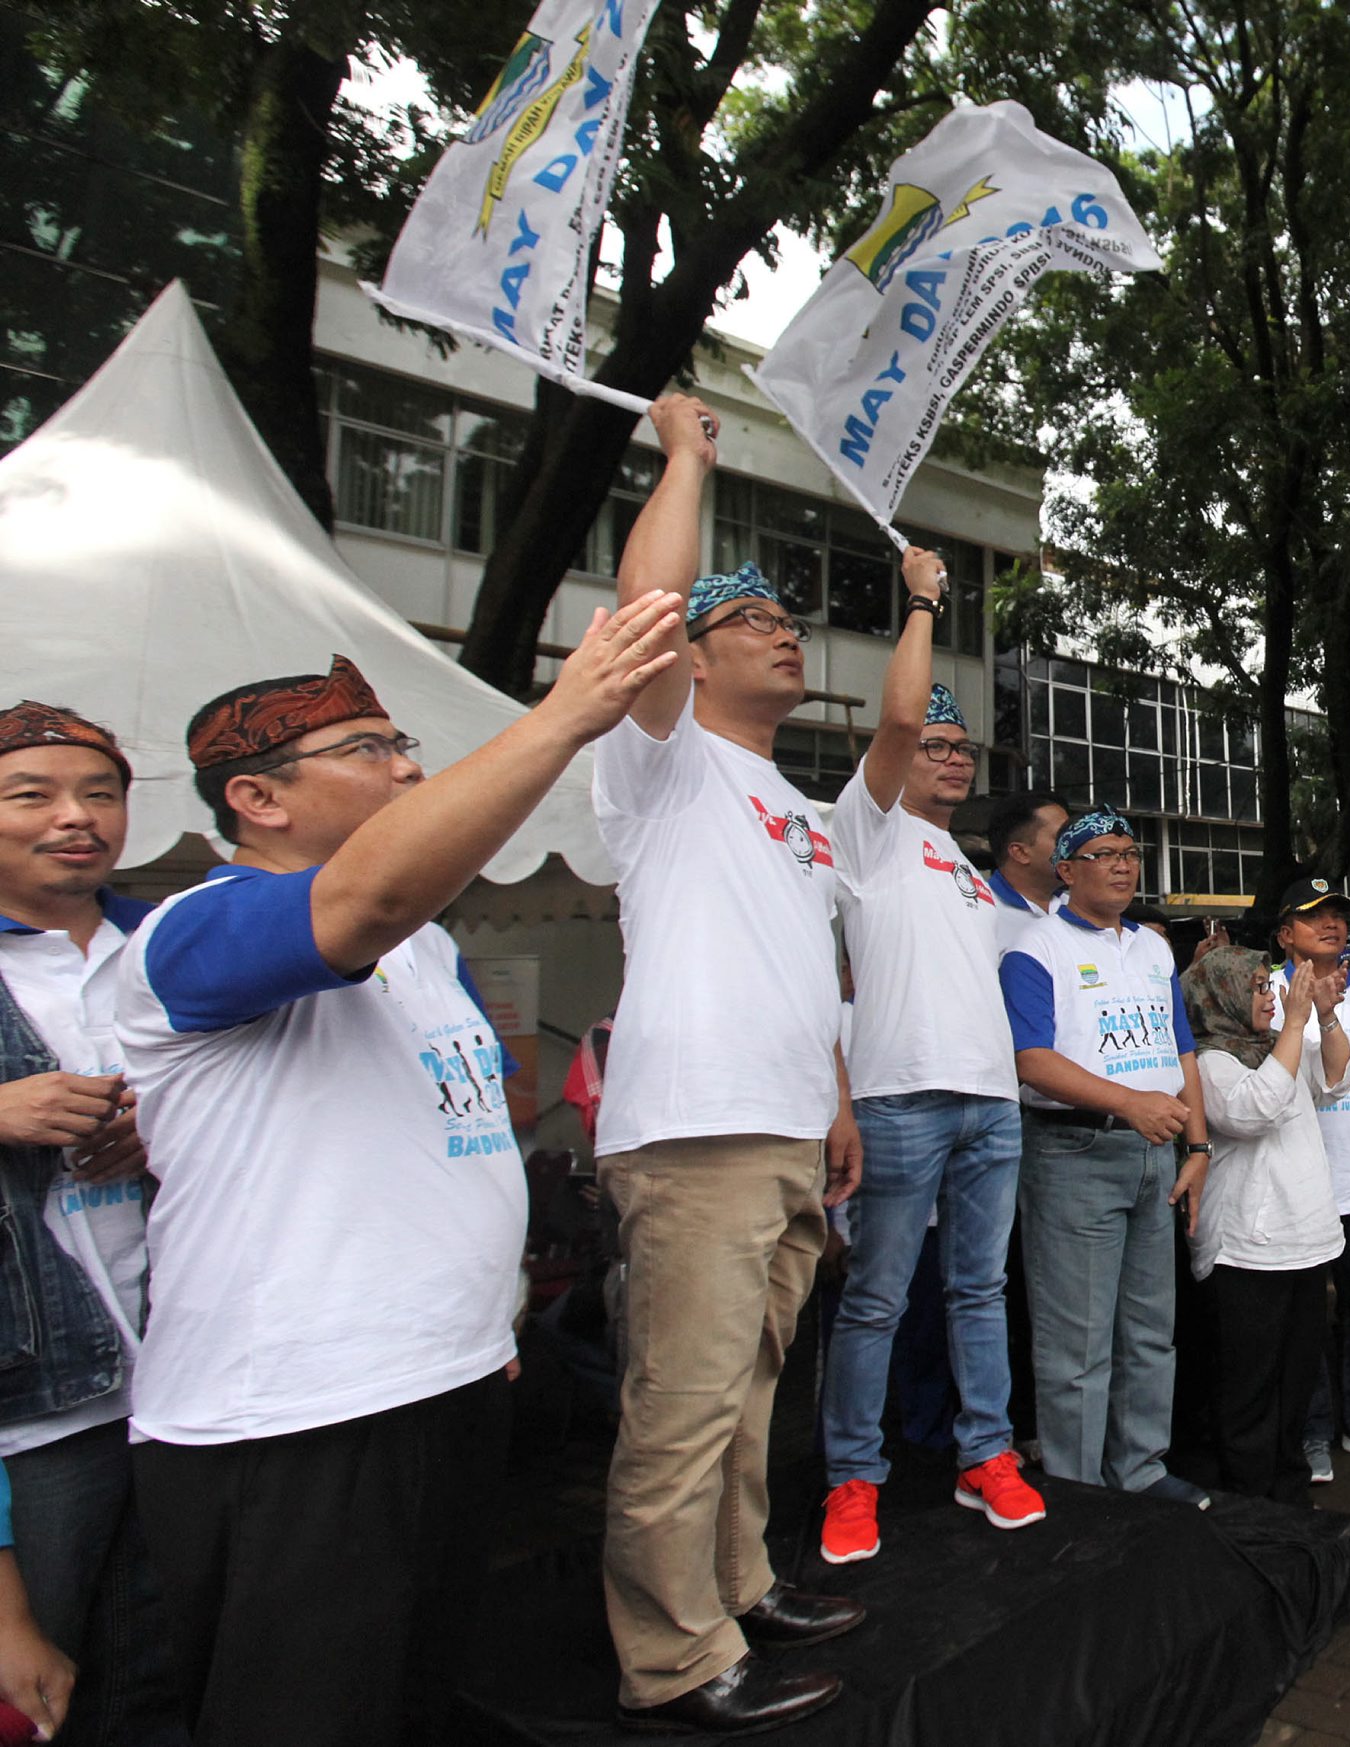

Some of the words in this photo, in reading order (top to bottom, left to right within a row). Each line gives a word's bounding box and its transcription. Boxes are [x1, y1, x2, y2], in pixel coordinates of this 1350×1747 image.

[533, 64, 613, 194] DAY
[838, 350, 907, 469] MAY
[899, 250, 953, 343] DA
[939, 290, 1014, 389] GASPERMINDO
[1098, 1012, 1142, 1035] MAY
[1106, 1057, 1159, 1076] BANDUNG
